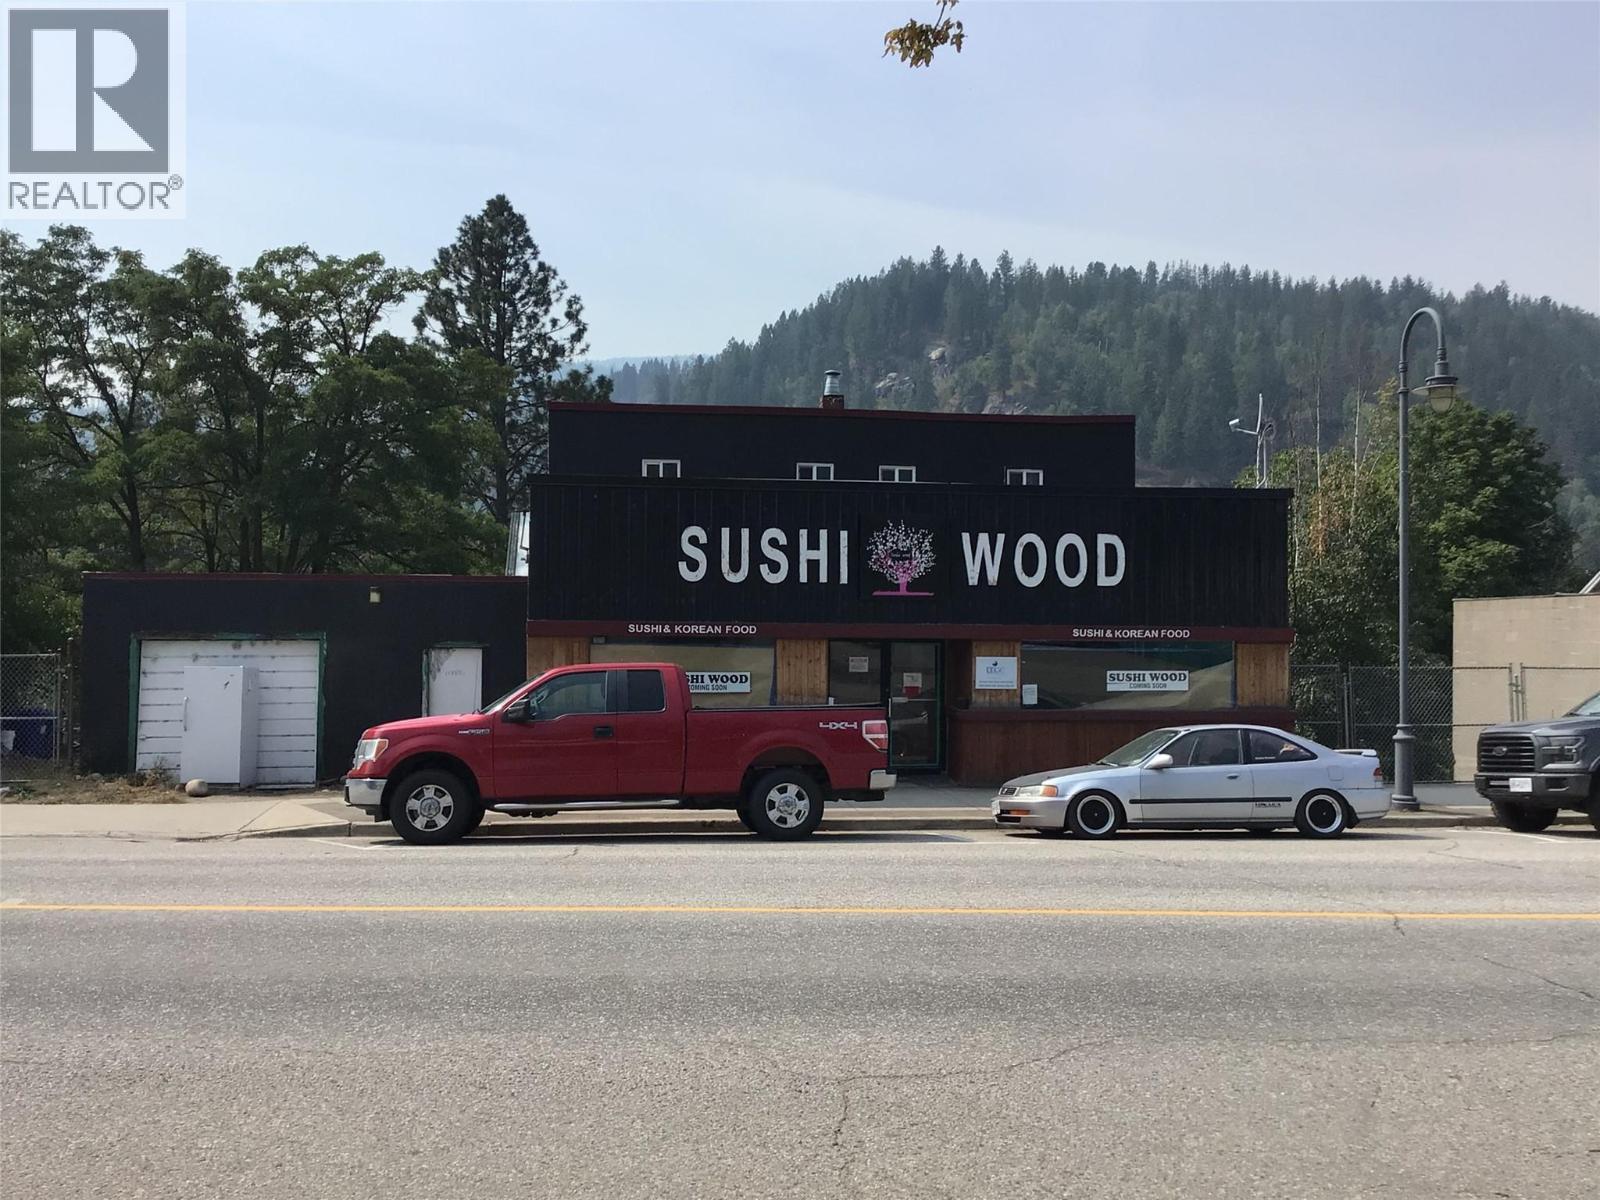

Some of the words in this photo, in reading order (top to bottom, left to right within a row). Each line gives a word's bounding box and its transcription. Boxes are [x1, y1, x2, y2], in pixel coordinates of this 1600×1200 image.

[677, 525, 848, 585] SUSHI
[961, 531, 1127, 588] WOOD
[674, 624, 722, 634] KOREAN
[725, 625, 757, 634] FOOD
[1072, 628, 1104, 637] SUSHI
[1114, 629, 1159, 638] KOREAN
[1160, 629, 1191, 638] FOOD
[707, 674, 748, 684] WOOD
[1108, 673, 1146, 682] SUSHI
[1149, 672, 1187, 682] WOOD
